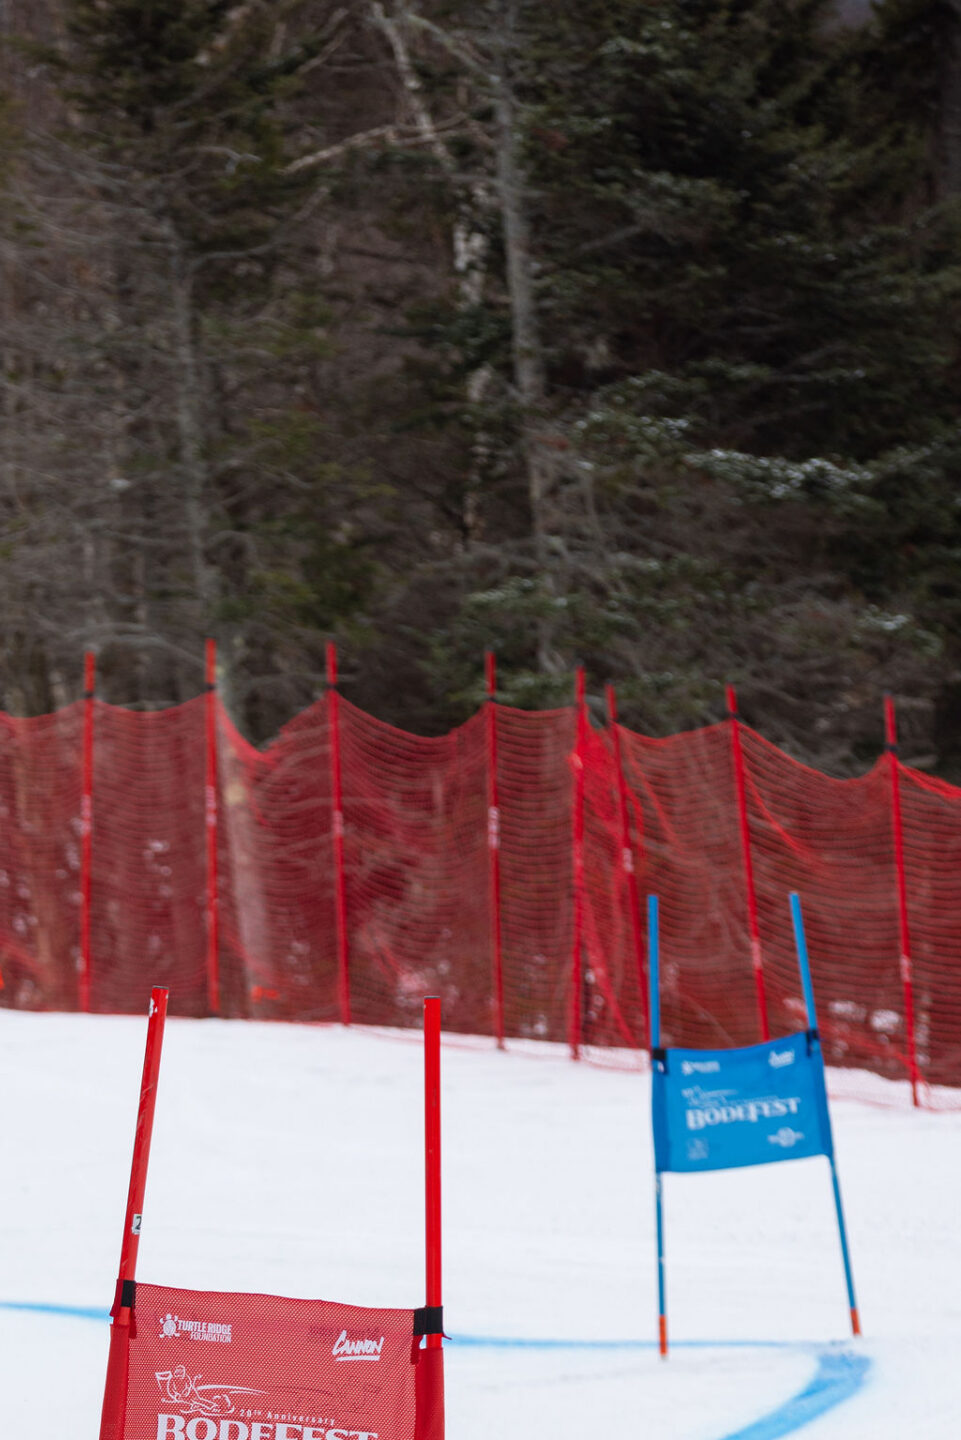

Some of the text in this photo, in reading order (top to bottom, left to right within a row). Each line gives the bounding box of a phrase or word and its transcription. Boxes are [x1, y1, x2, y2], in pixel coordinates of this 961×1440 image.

[177, 1320, 232, 1334] TURTLE RIDGE
[190, 1331, 232, 1343] FOUNDATION
[266, 1411, 335, 1426] Anniversary
